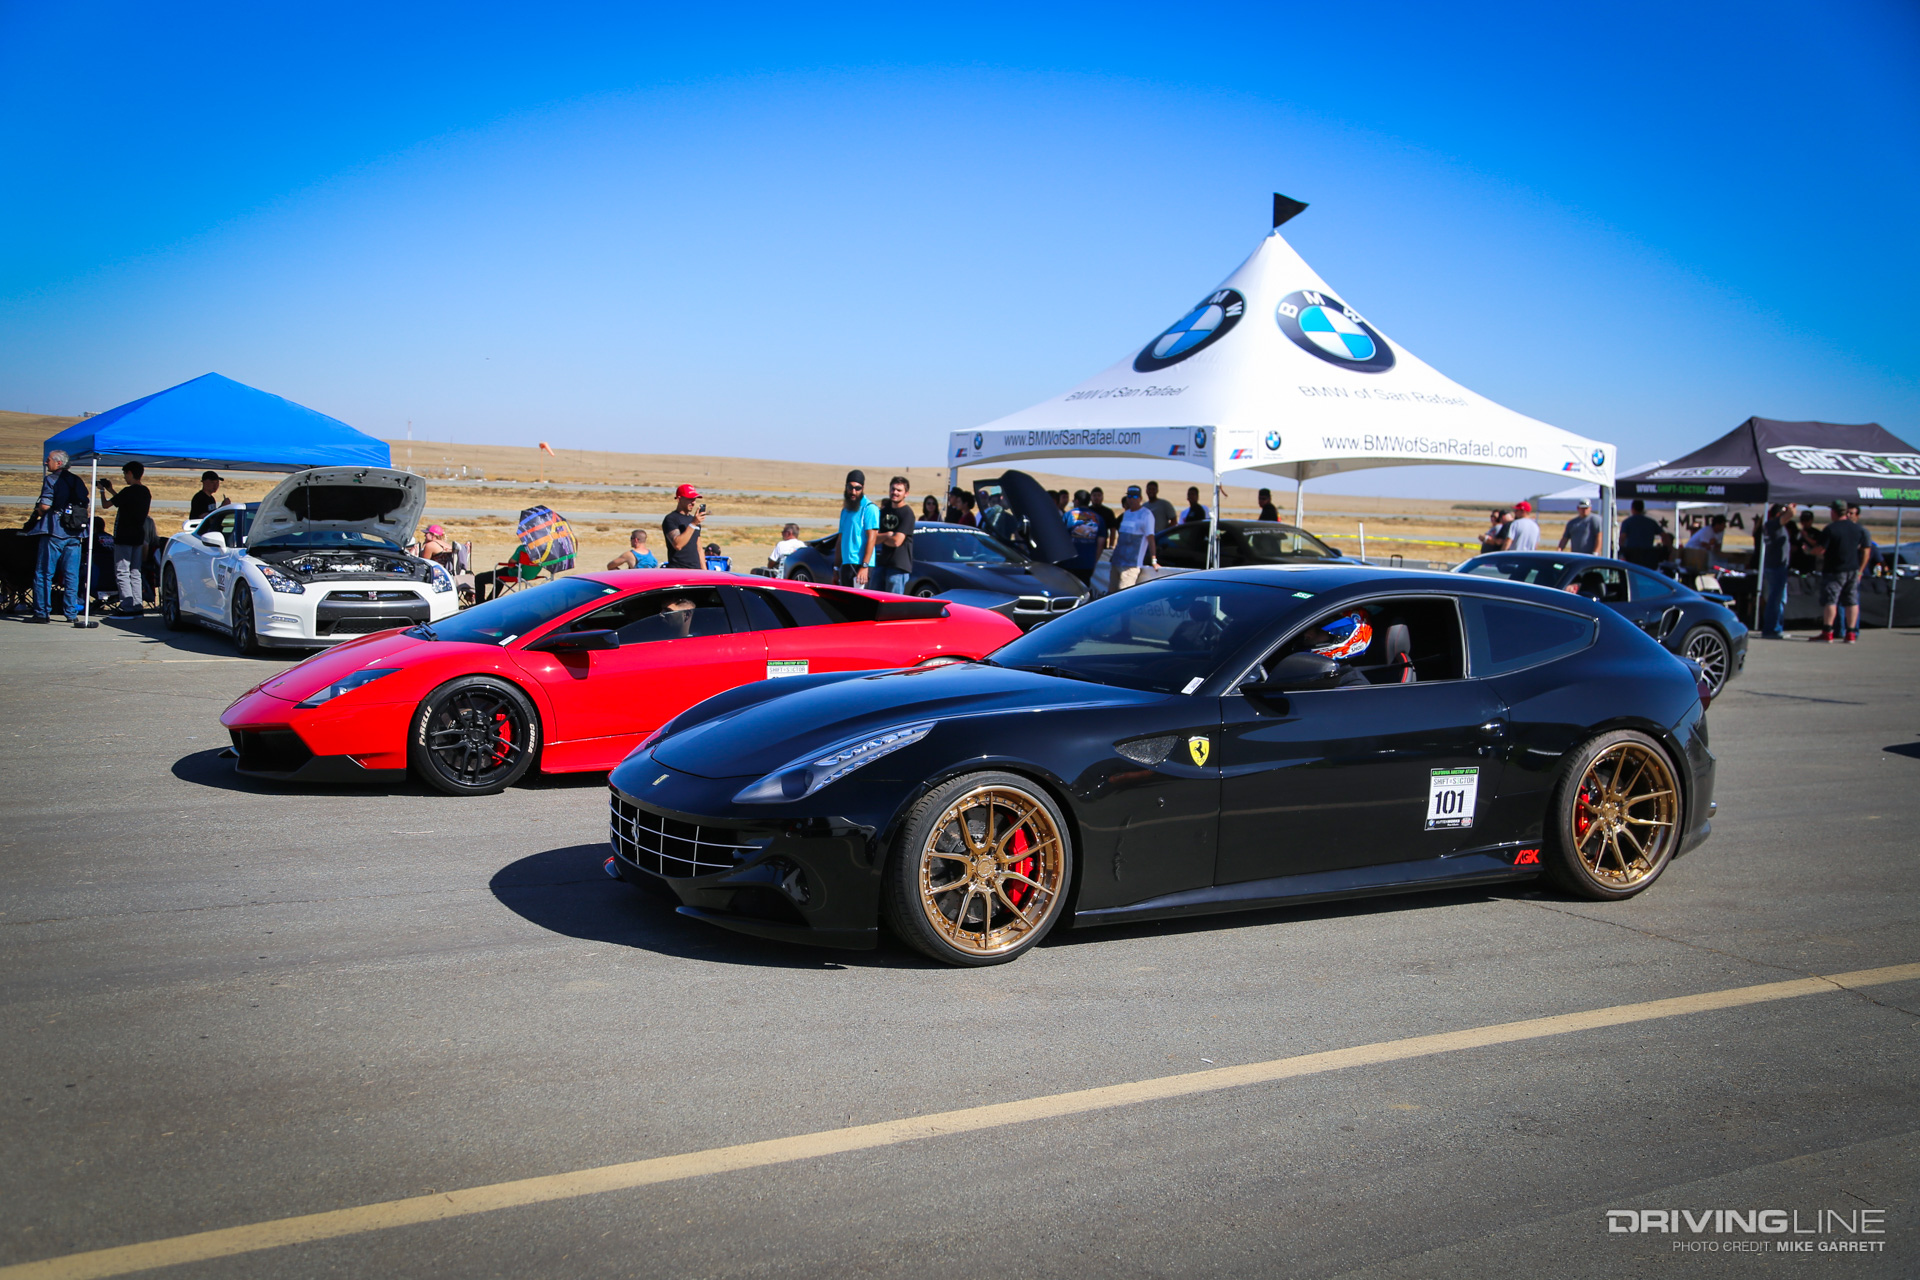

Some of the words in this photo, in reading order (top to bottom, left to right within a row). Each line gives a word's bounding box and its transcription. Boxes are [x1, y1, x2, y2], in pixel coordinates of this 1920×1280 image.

[1113, 386, 1141, 398] San
[1140, 385, 1189, 397] Rafael
[1298, 385, 1349, 398] BMW
[1354, 388, 1372, 399] of
[1373, 388, 1411, 402] San
[1411, 391, 1469, 406] Rafael
[1004, 429, 1141, 446] www.BMWofSanRafael.com
[1322, 434, 1528, 459] www.BMWofSanRafael.com
[1776, 449, 1857, 470] SHIFT
[1858, 455, 1920, 475] S3CT
[418, 705, 433, 747] PIRELLI
[527, 723, 536, 754] CORSA
[1435, 789, 1465, 815] 101
